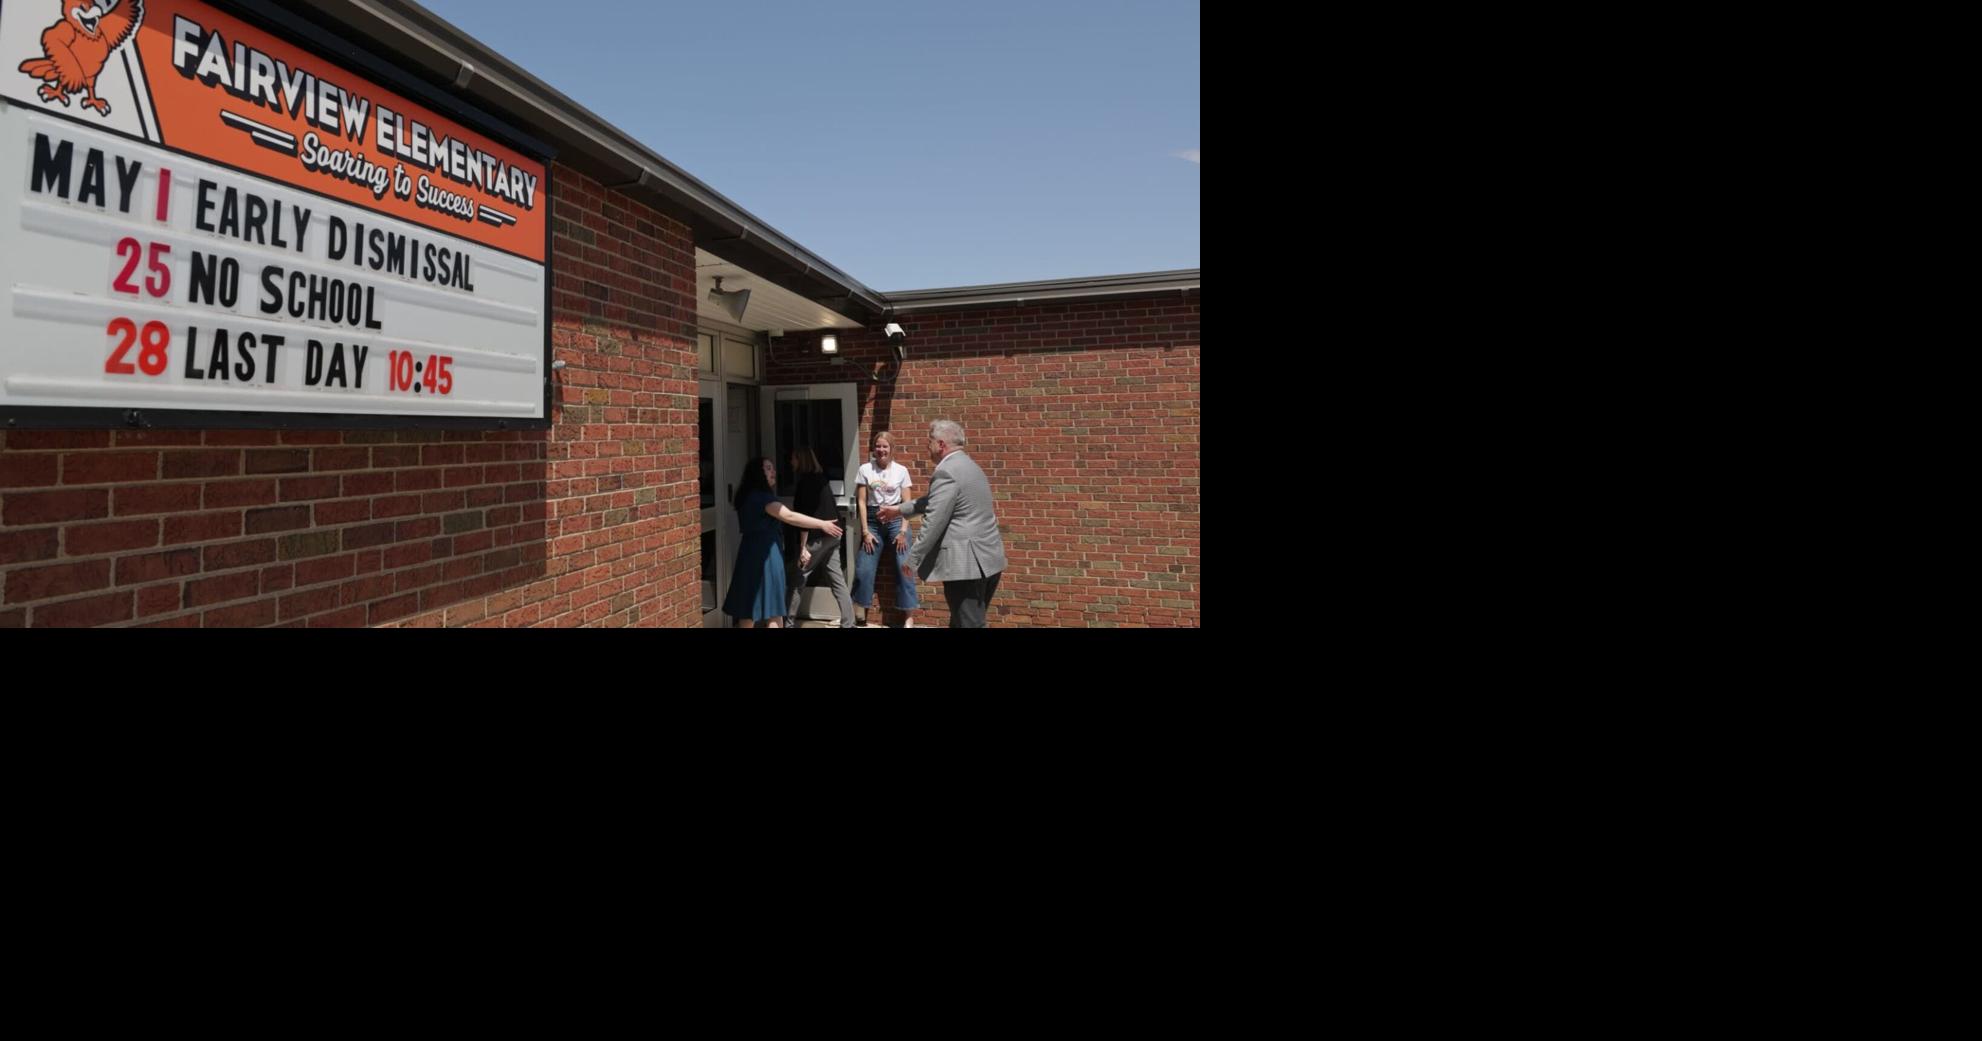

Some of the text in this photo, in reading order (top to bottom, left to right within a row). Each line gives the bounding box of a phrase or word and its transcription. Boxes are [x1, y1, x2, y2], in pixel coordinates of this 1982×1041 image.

[171, 13, 538, 209] FAIRVIEW ELEMENTARY
[29, 132, 142, 213] MAY
[194, 178, 312, 255] EARLY
[327, 215, 475, 292] DISMISSAL
[299, 131, 475, 220] Soaring to Success
[111, 236, 382, 330] 25 NO SCHOOL
[103, 317, 453, 396] 28 LAST DAY 10:45
